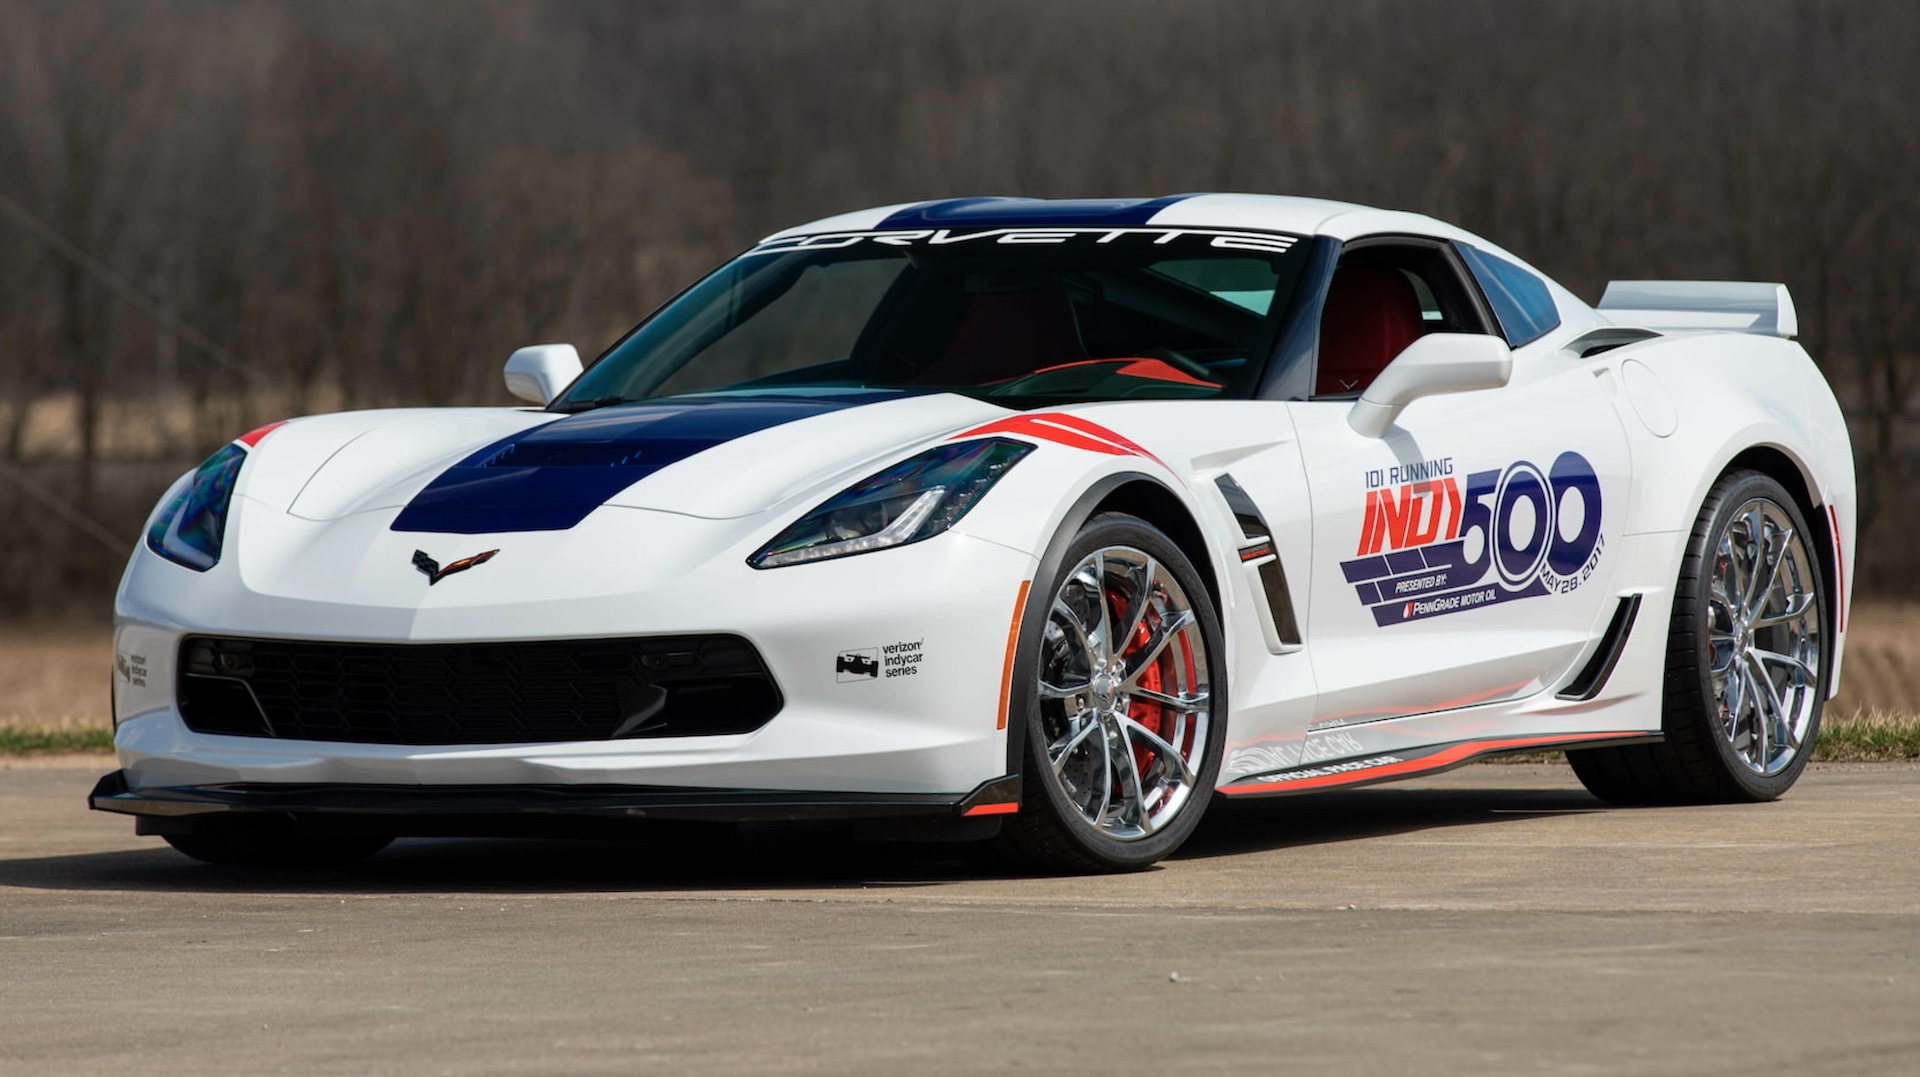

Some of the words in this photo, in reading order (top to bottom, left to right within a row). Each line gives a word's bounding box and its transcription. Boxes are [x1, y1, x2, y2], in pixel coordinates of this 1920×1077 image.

[742, 228, 1298, 256] CORVETTE
[1389, 457, 1453, 485] RUNNING
[1395, 575, 1435, 594] PRESENTED
[1435, 573, 1448, 587] BY:
[1460, 592, 1485, 607] MOTOR
[1485, 588, 1497, 602] OIL
[882, 641, 921, 654] verizon
[885, 653, 923, 667] indycar
[885, 665, 918, 678] series
